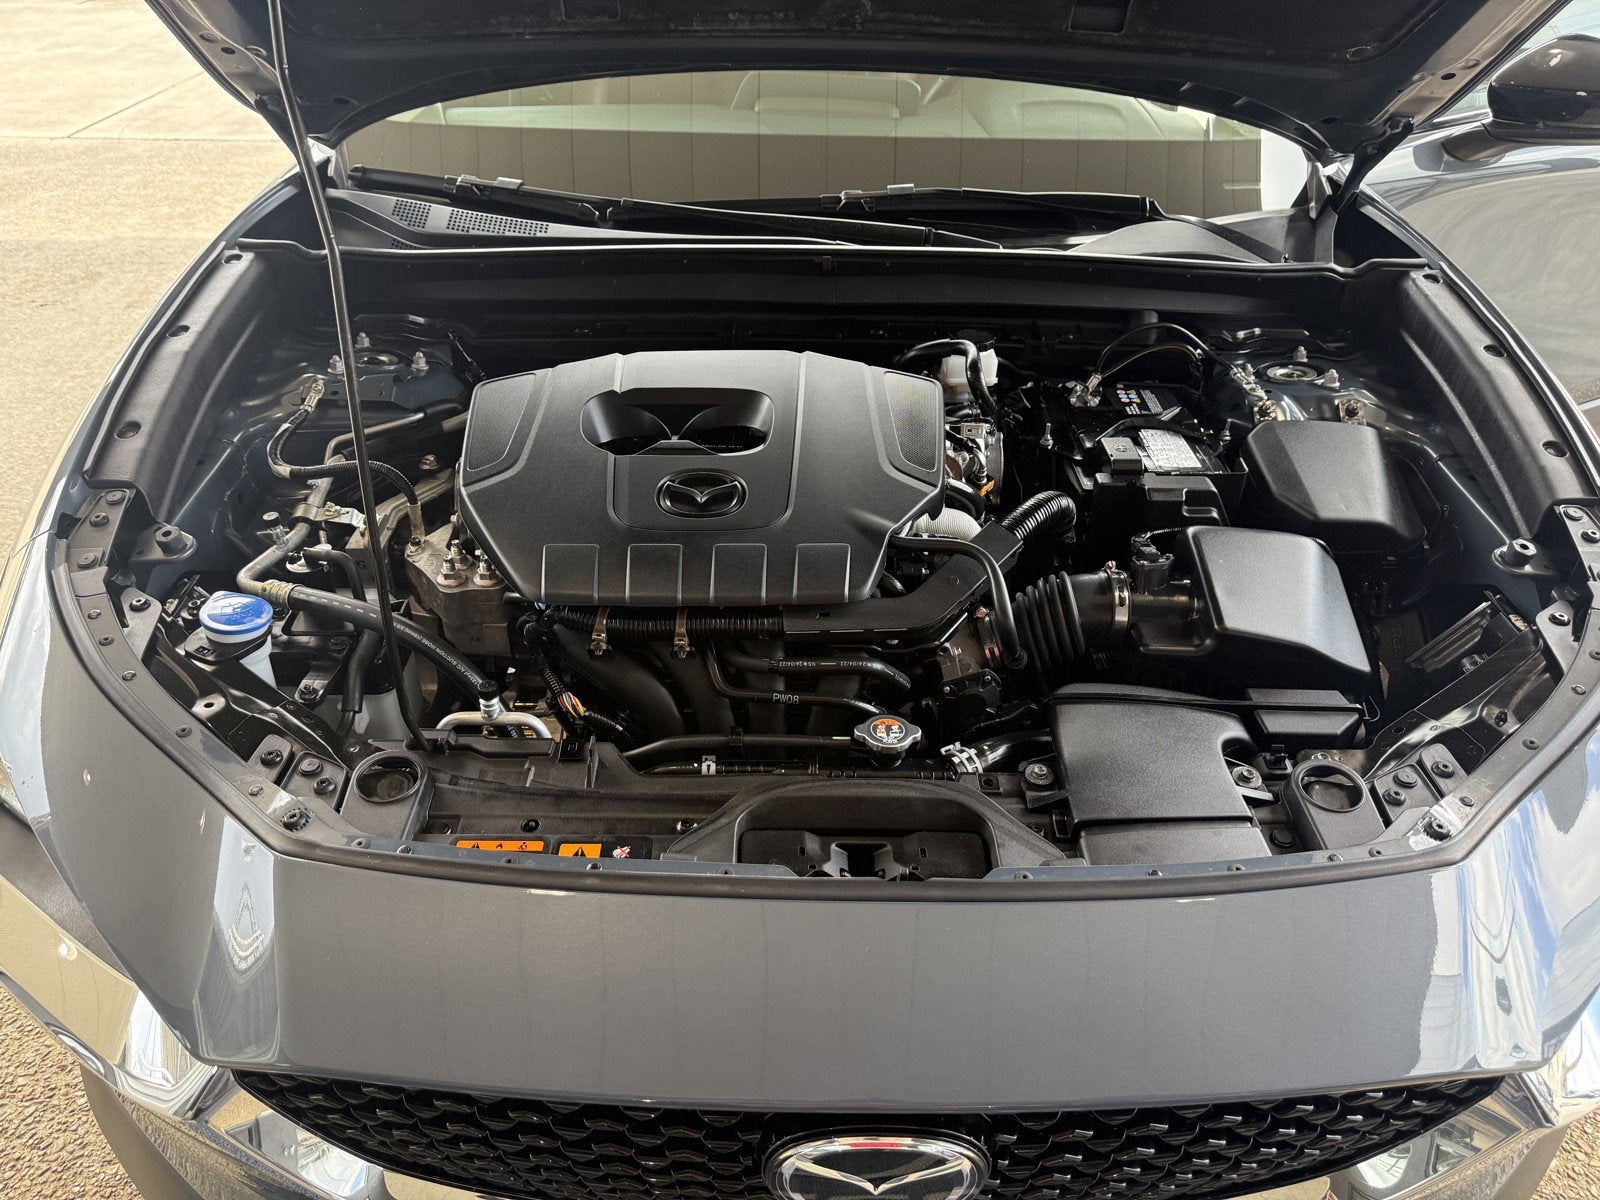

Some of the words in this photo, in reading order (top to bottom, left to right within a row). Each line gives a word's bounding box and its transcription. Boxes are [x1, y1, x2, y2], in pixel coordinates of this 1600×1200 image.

[420, 637, 437, 650] HOSE
[436, 648, 458, 666] SUCTION
[772, 692, 800, 705] PW08
